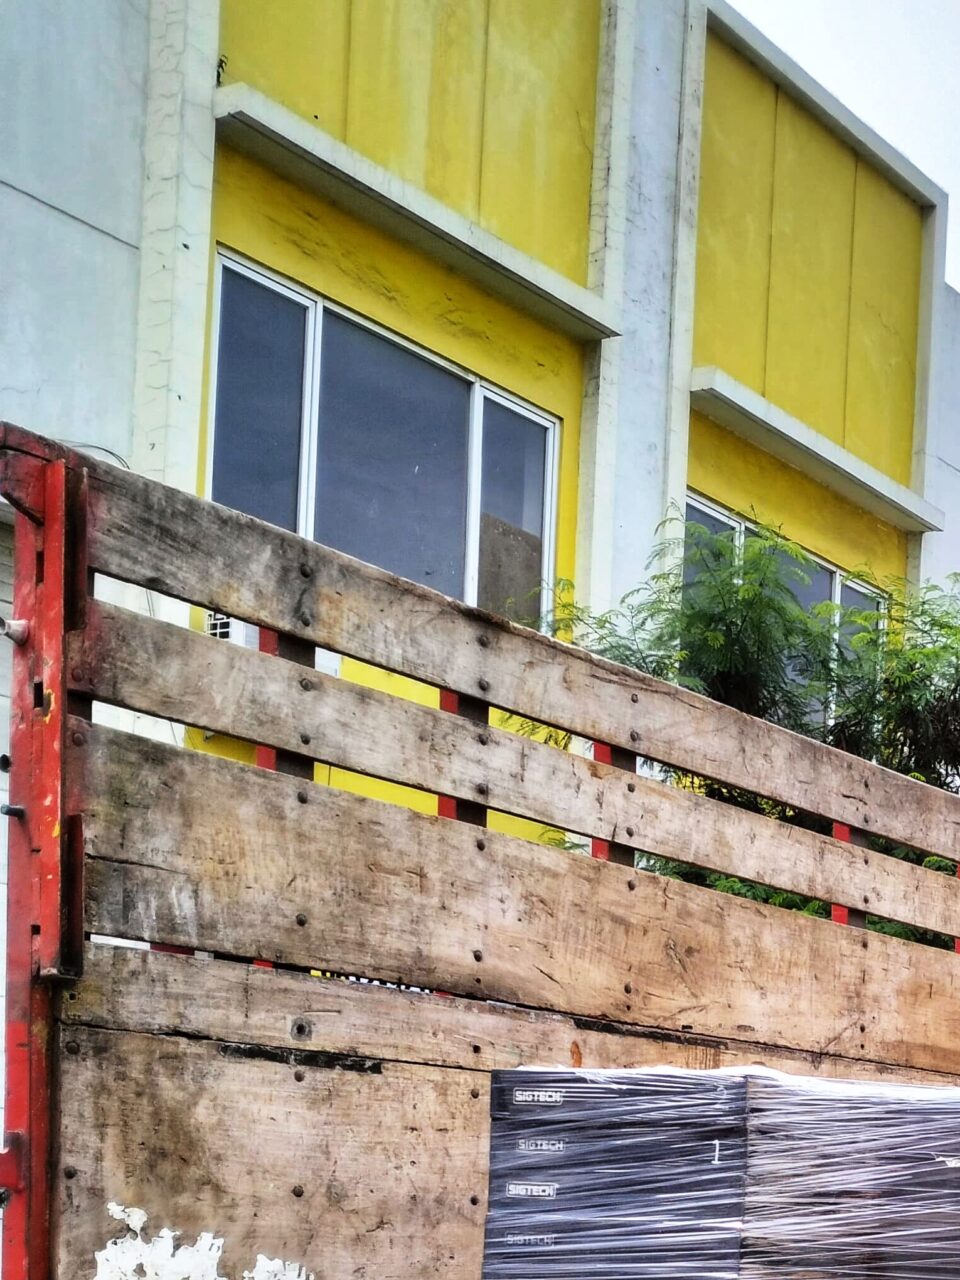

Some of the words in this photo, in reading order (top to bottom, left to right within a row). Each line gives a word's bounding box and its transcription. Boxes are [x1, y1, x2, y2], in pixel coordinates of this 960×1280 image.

[514, 1089, 562, 1103] SIGTECH
[517, 1138, 564, 1151] SIGTECH
[507, 1183, 555, 1197] SIGTECH
